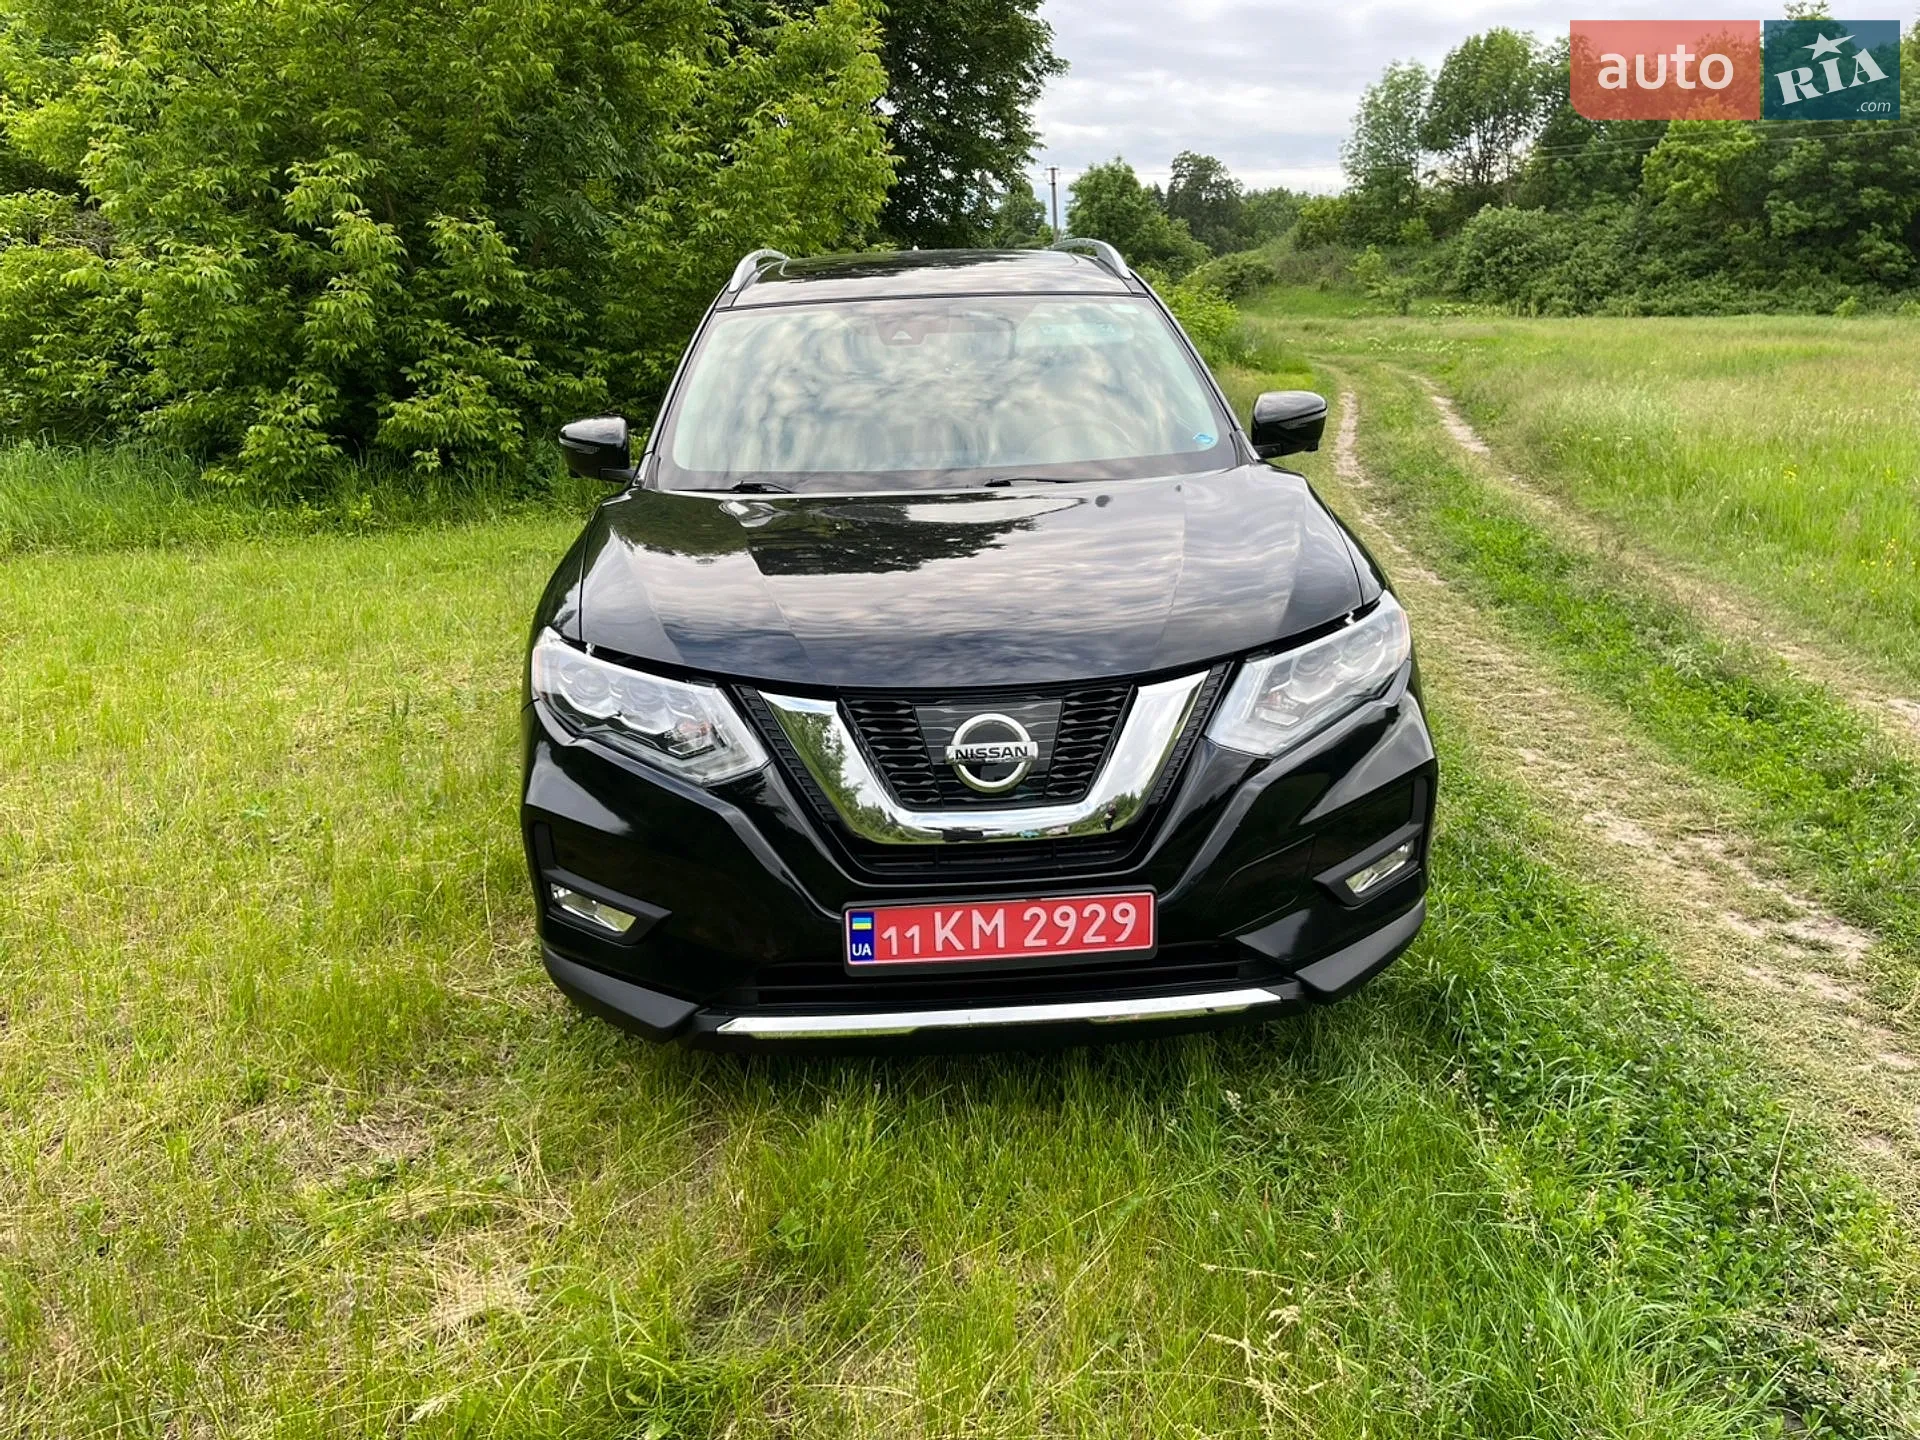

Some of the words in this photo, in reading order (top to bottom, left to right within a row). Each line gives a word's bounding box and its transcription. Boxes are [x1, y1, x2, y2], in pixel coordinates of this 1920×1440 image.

[955, 746, 1028, 760] NISSAN
[1022, 902, 1137, 947] 2929
[852, 943, 872, 957] UA
